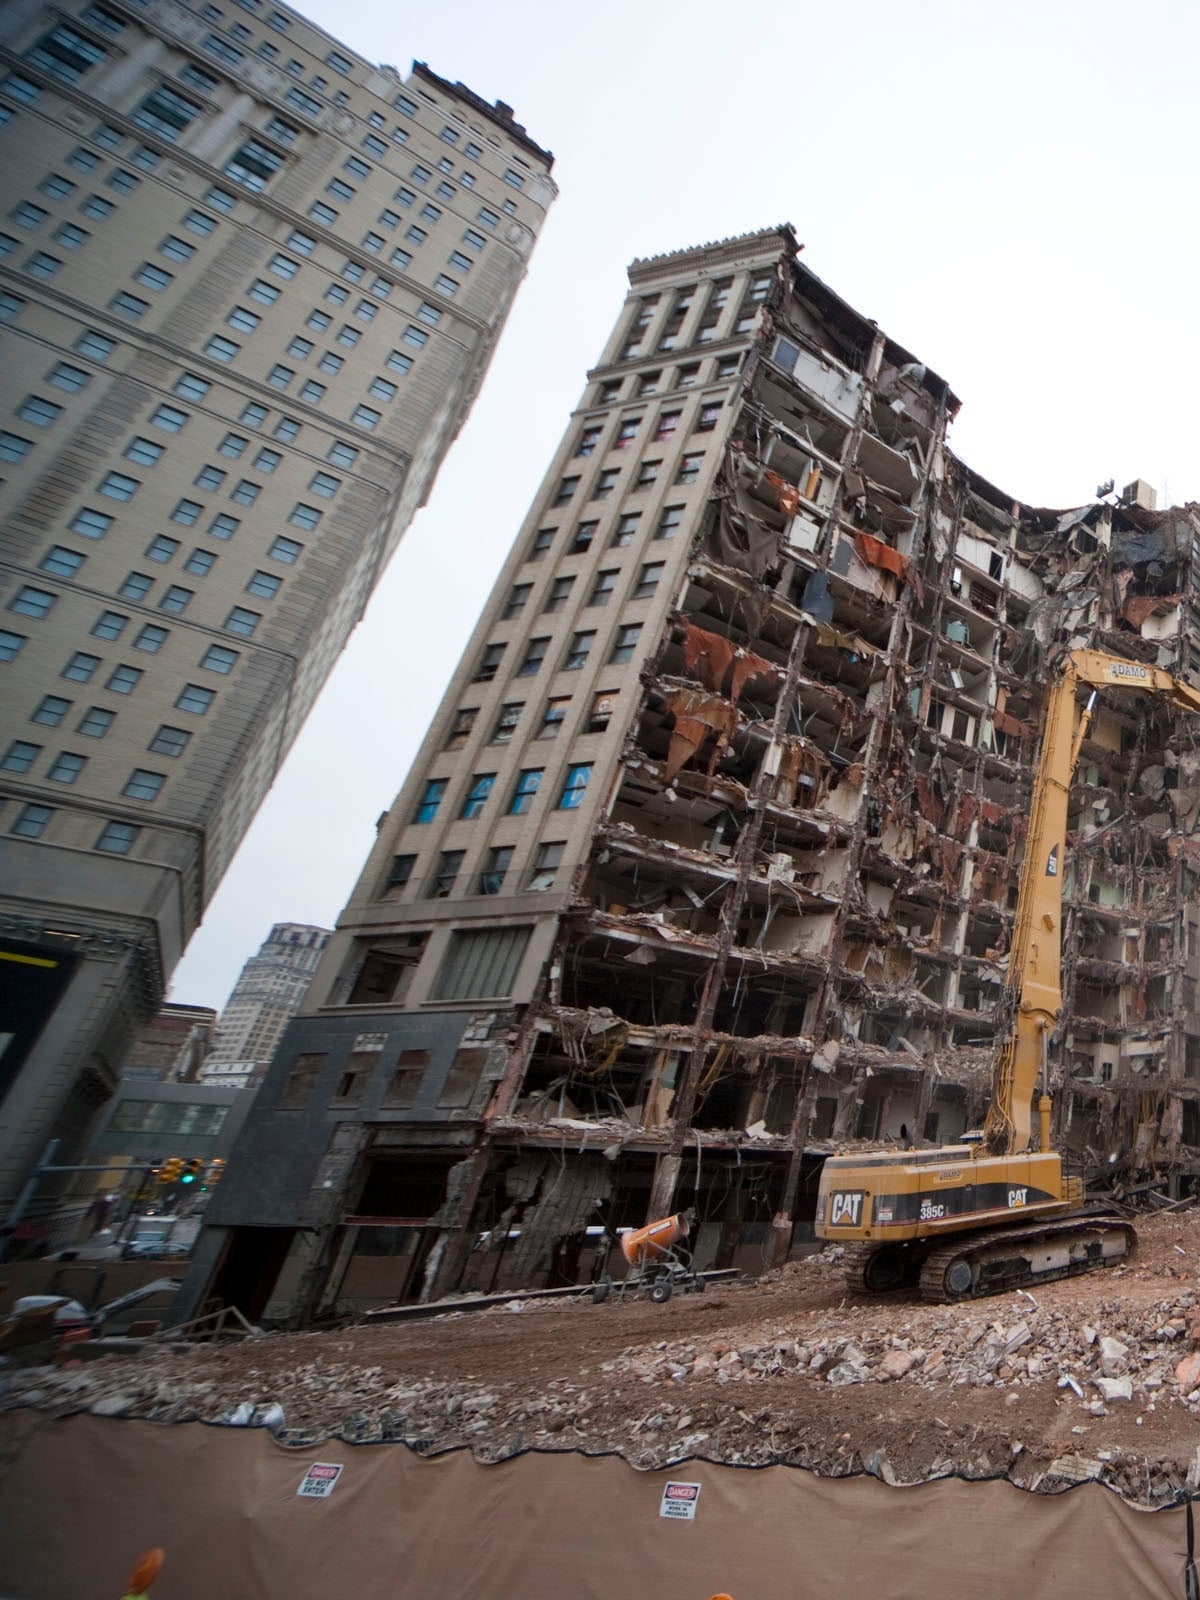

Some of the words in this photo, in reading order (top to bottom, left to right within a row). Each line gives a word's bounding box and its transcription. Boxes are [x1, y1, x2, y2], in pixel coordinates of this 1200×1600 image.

[1110, 662, 1147, 678] ADAMO
[1048, 855, 1057, 873] CAT
[1008, 1189, 1028, 1208] CAT
[831, 1193, 862, 1225] CAT
[920, 1204, 944, 1220] 385C
[668, 1486, 696, 1498] DANGER
